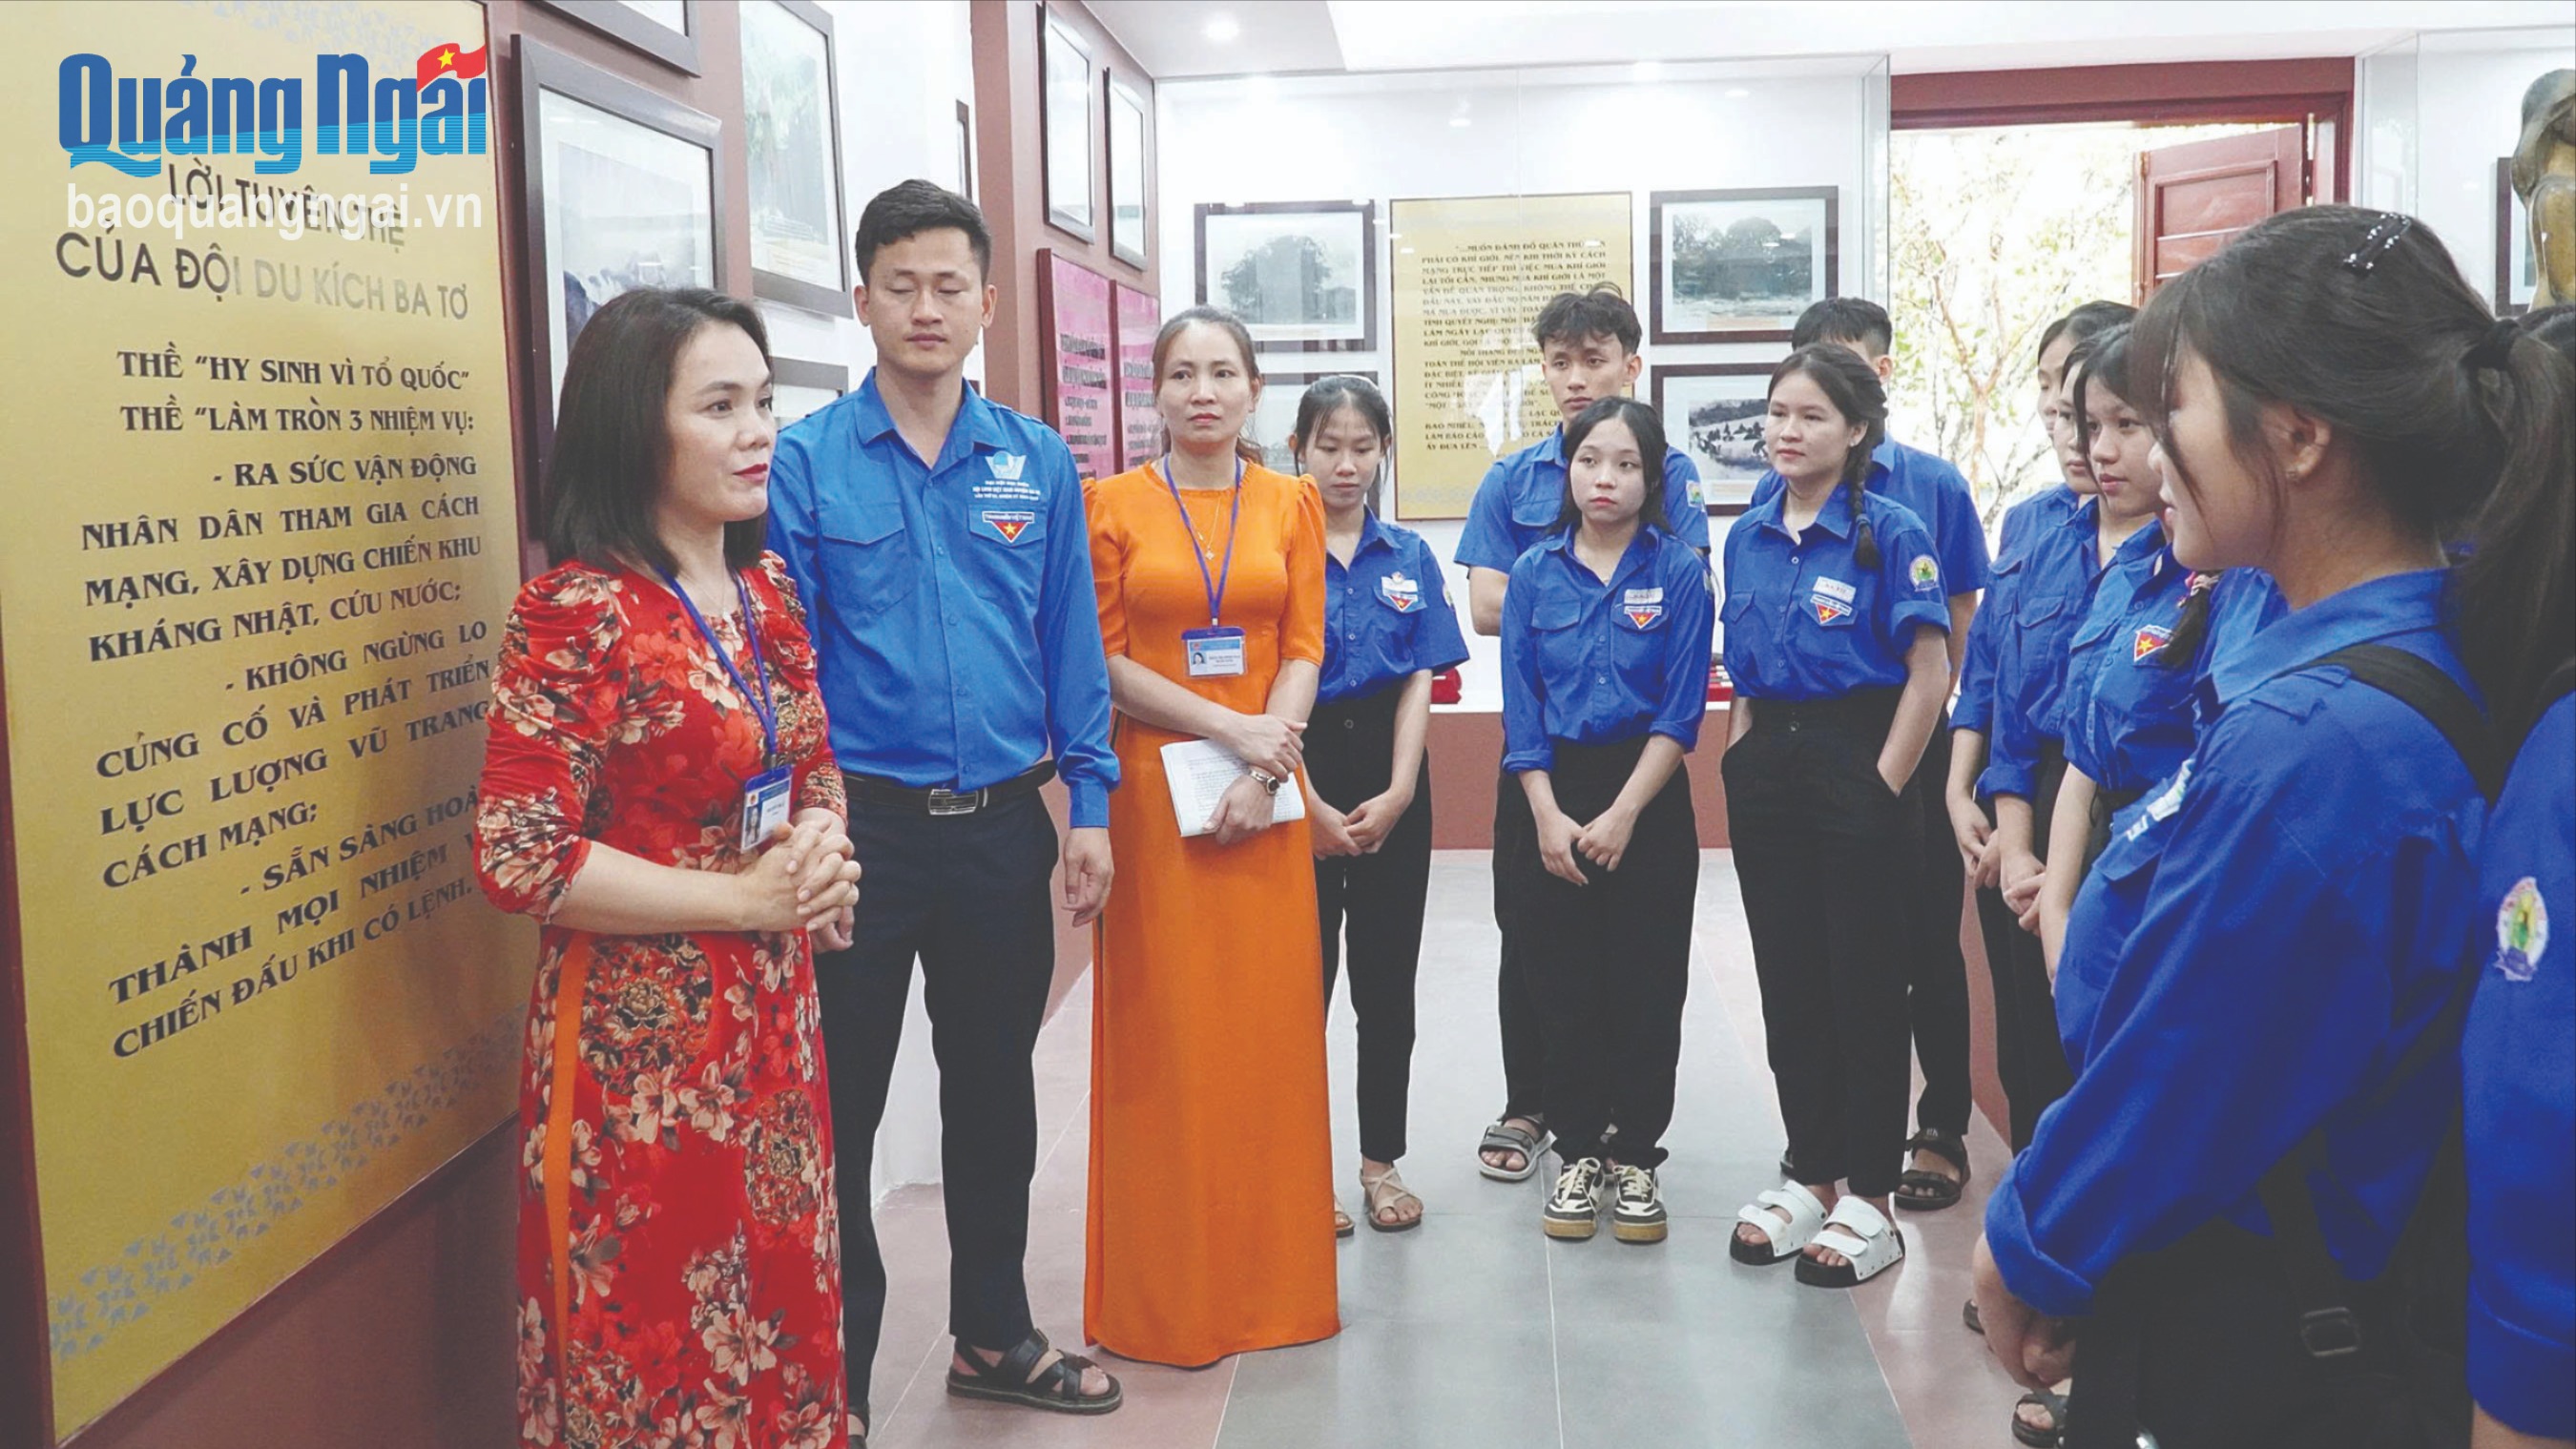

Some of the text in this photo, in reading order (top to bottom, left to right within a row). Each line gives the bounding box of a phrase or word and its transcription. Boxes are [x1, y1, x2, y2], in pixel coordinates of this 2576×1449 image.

[56, 218, 468, 320] CỦA ĐỘI DU KÍCH BA TƠ
[117, 342, 183, 378] THỀ
[260, 359, 322, 384] SINH
[330, 357, 355, 385] VÌ
[361, 356, 393, 386] TỔ
[120, 394, 183, 431] THỀ
[276, 397, 342, 431] TRÒN
[349, 410, 363, 430] 3
[370, 405, 435, 437] NHIỆM
[442, 411, 473, 436] VỤ:
[235, 463, 279, 486] RA
[290, 455, 346, 484] SỨC
[354, 454, 404, 486] VẬN
[410, 453, 476, 483] ĐỘNG
[82, 493, 479, 550] NHÂN DÂN THAM GIA CÁCH
[85, 534, 481, 610] MẠNG, XÂY DỰNG CHIẾN KHU
[90, 577, 461, 662] KHÁNG NHẬT, CỨU NƯỚC;
[246, 649, 347, 691] KHÔNG
[364, 630, 445, 664] NGỪNG
[459, 621, 488, 644] LO
[96, 653, 490, 778] CỦNG CỐ VÀ PHÁT TRIỂN
[100, 701, 488, 835] LỰC LƯỢNG VŨ TRANG
[103, 801, 318, 888] CÁCH MẠNG;
[262, 845, 330, 892] SẴN
[340, 824, 418, 861] SÀNG
[426, 784, 478, 827] HOÀ
[108, 844, 447, 1004] THÀNH MỌI NHIỆM
[113, 878, 472, 1058] CHIẾN ĐẤU KHI CÓ LỆNH.
